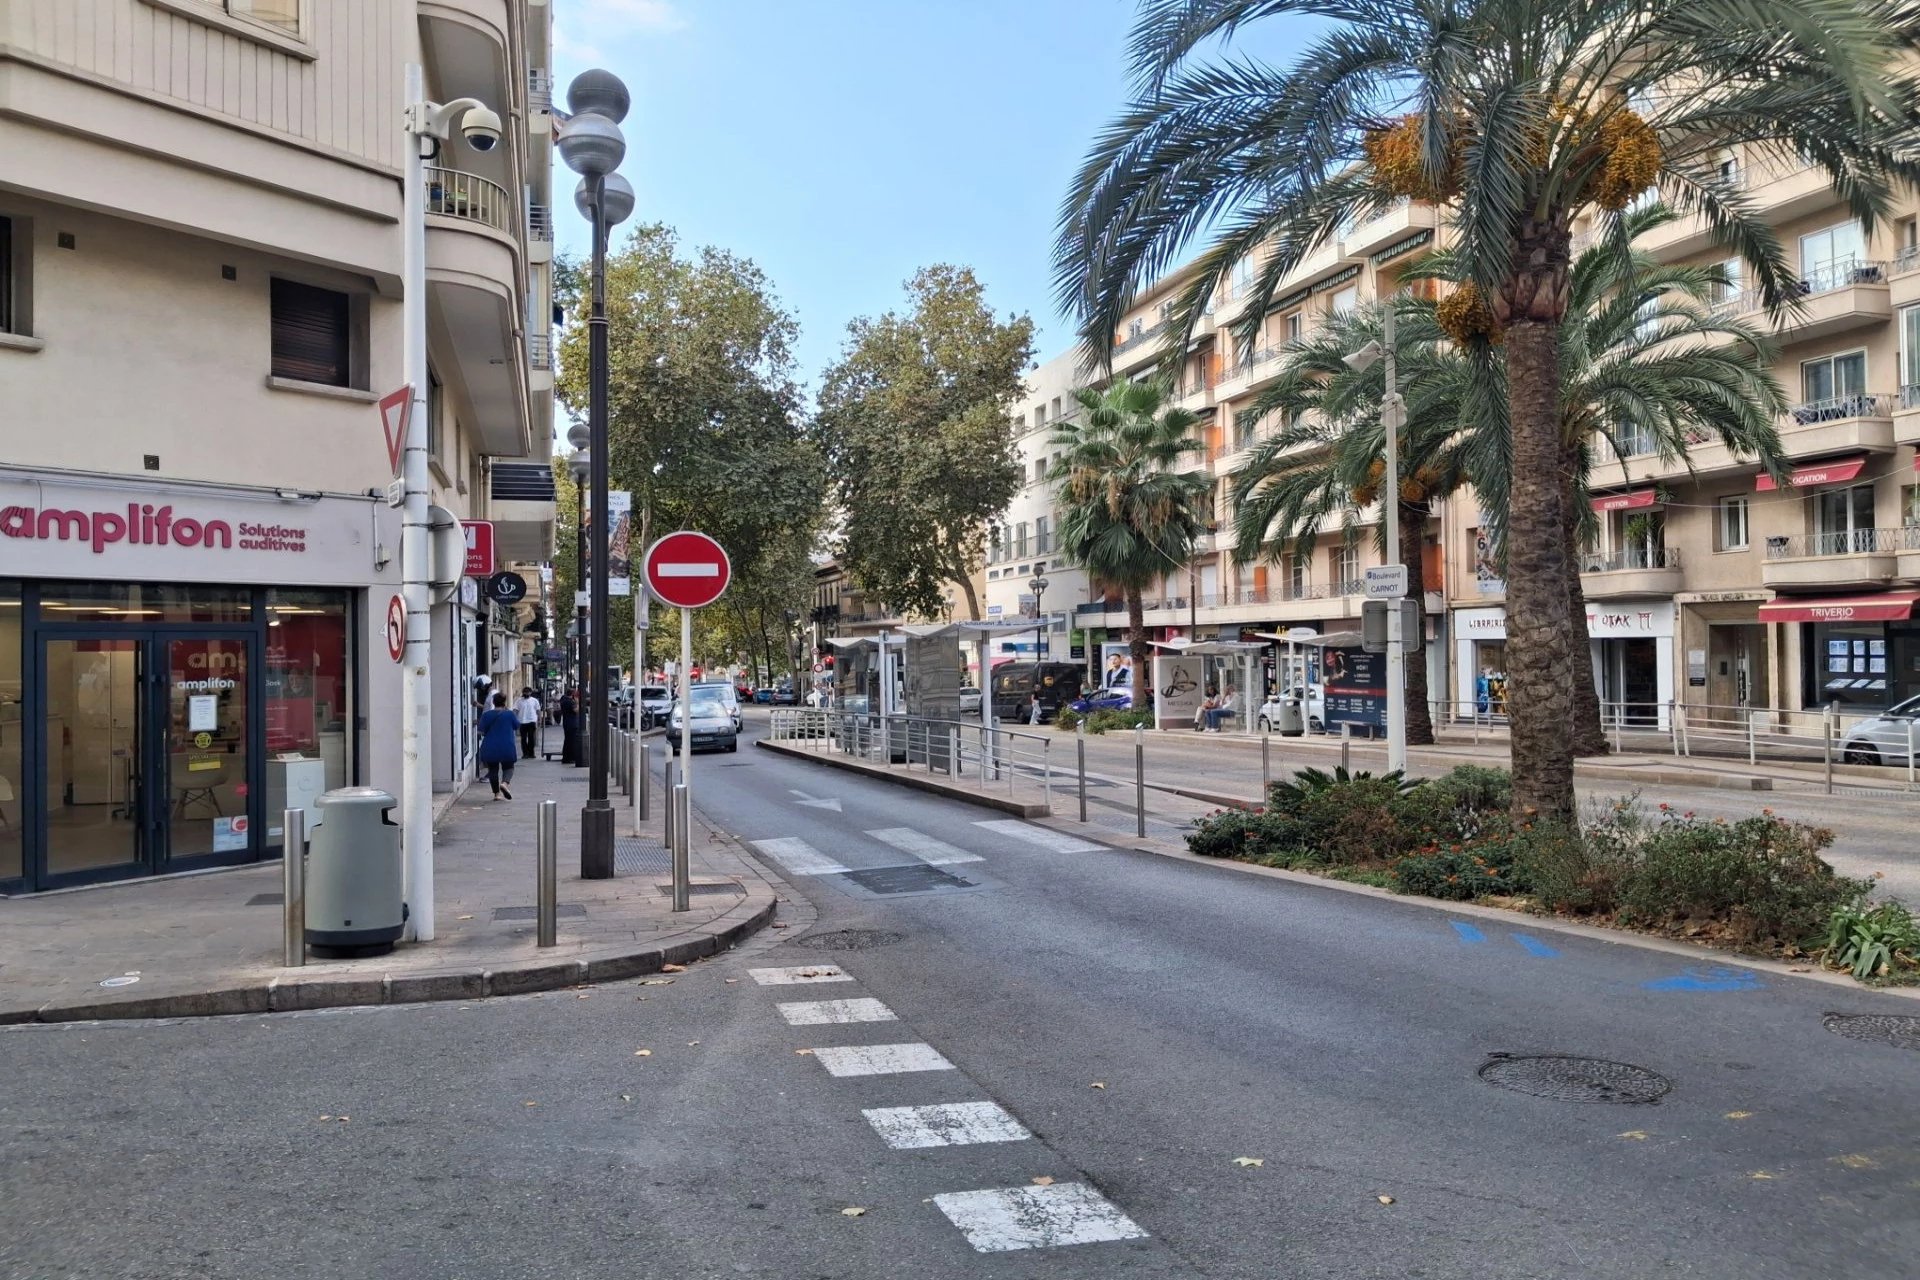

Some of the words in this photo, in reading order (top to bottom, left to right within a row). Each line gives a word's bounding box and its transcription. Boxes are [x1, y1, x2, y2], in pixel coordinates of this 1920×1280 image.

[1790, 473, 1827, 485] OCATION
[0, 503, 232, 553] amplifon
[239, 522, 305, 539] Solutions
[239, 537, 306, 552] auditives
[1372, 572, 1401, 580] Boulevard
[1370, 584, 1399, 593] CARNOT
[1810, 607, 1854, 617] TRIVERIO
[176, 677, 236, 691] amplifon
